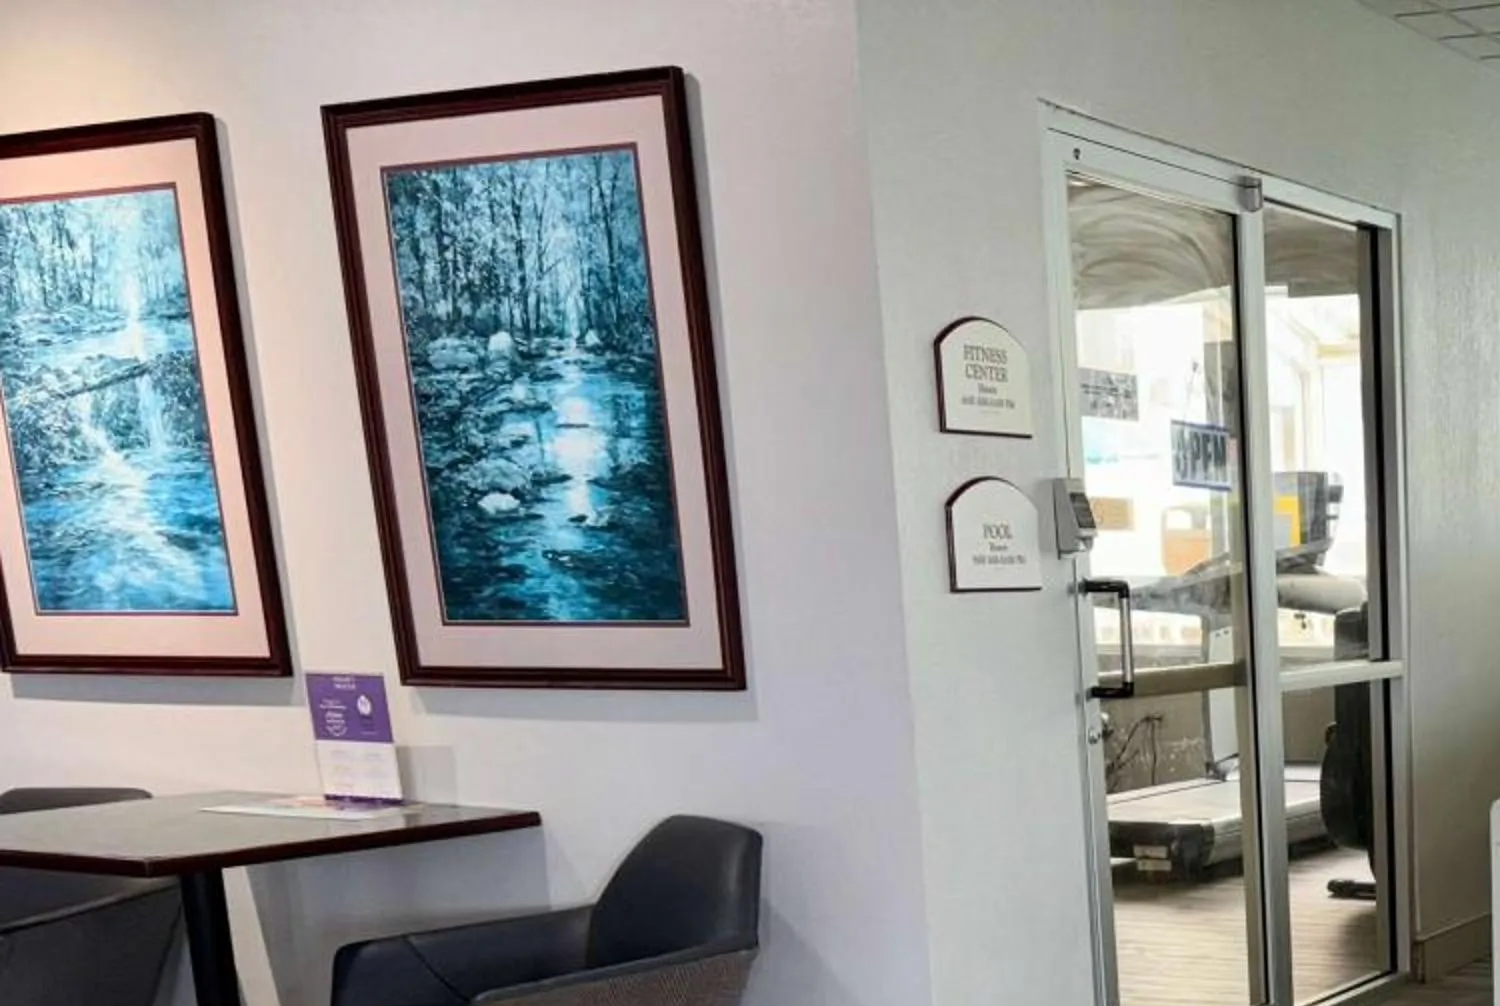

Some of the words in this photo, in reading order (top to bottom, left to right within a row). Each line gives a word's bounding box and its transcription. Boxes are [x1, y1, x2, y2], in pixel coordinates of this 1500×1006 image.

[963, 344, 1008, 365] FITNESS
[965, 363, 1009, 383] CENTER
[982, 523, 1014, 540] POOL
